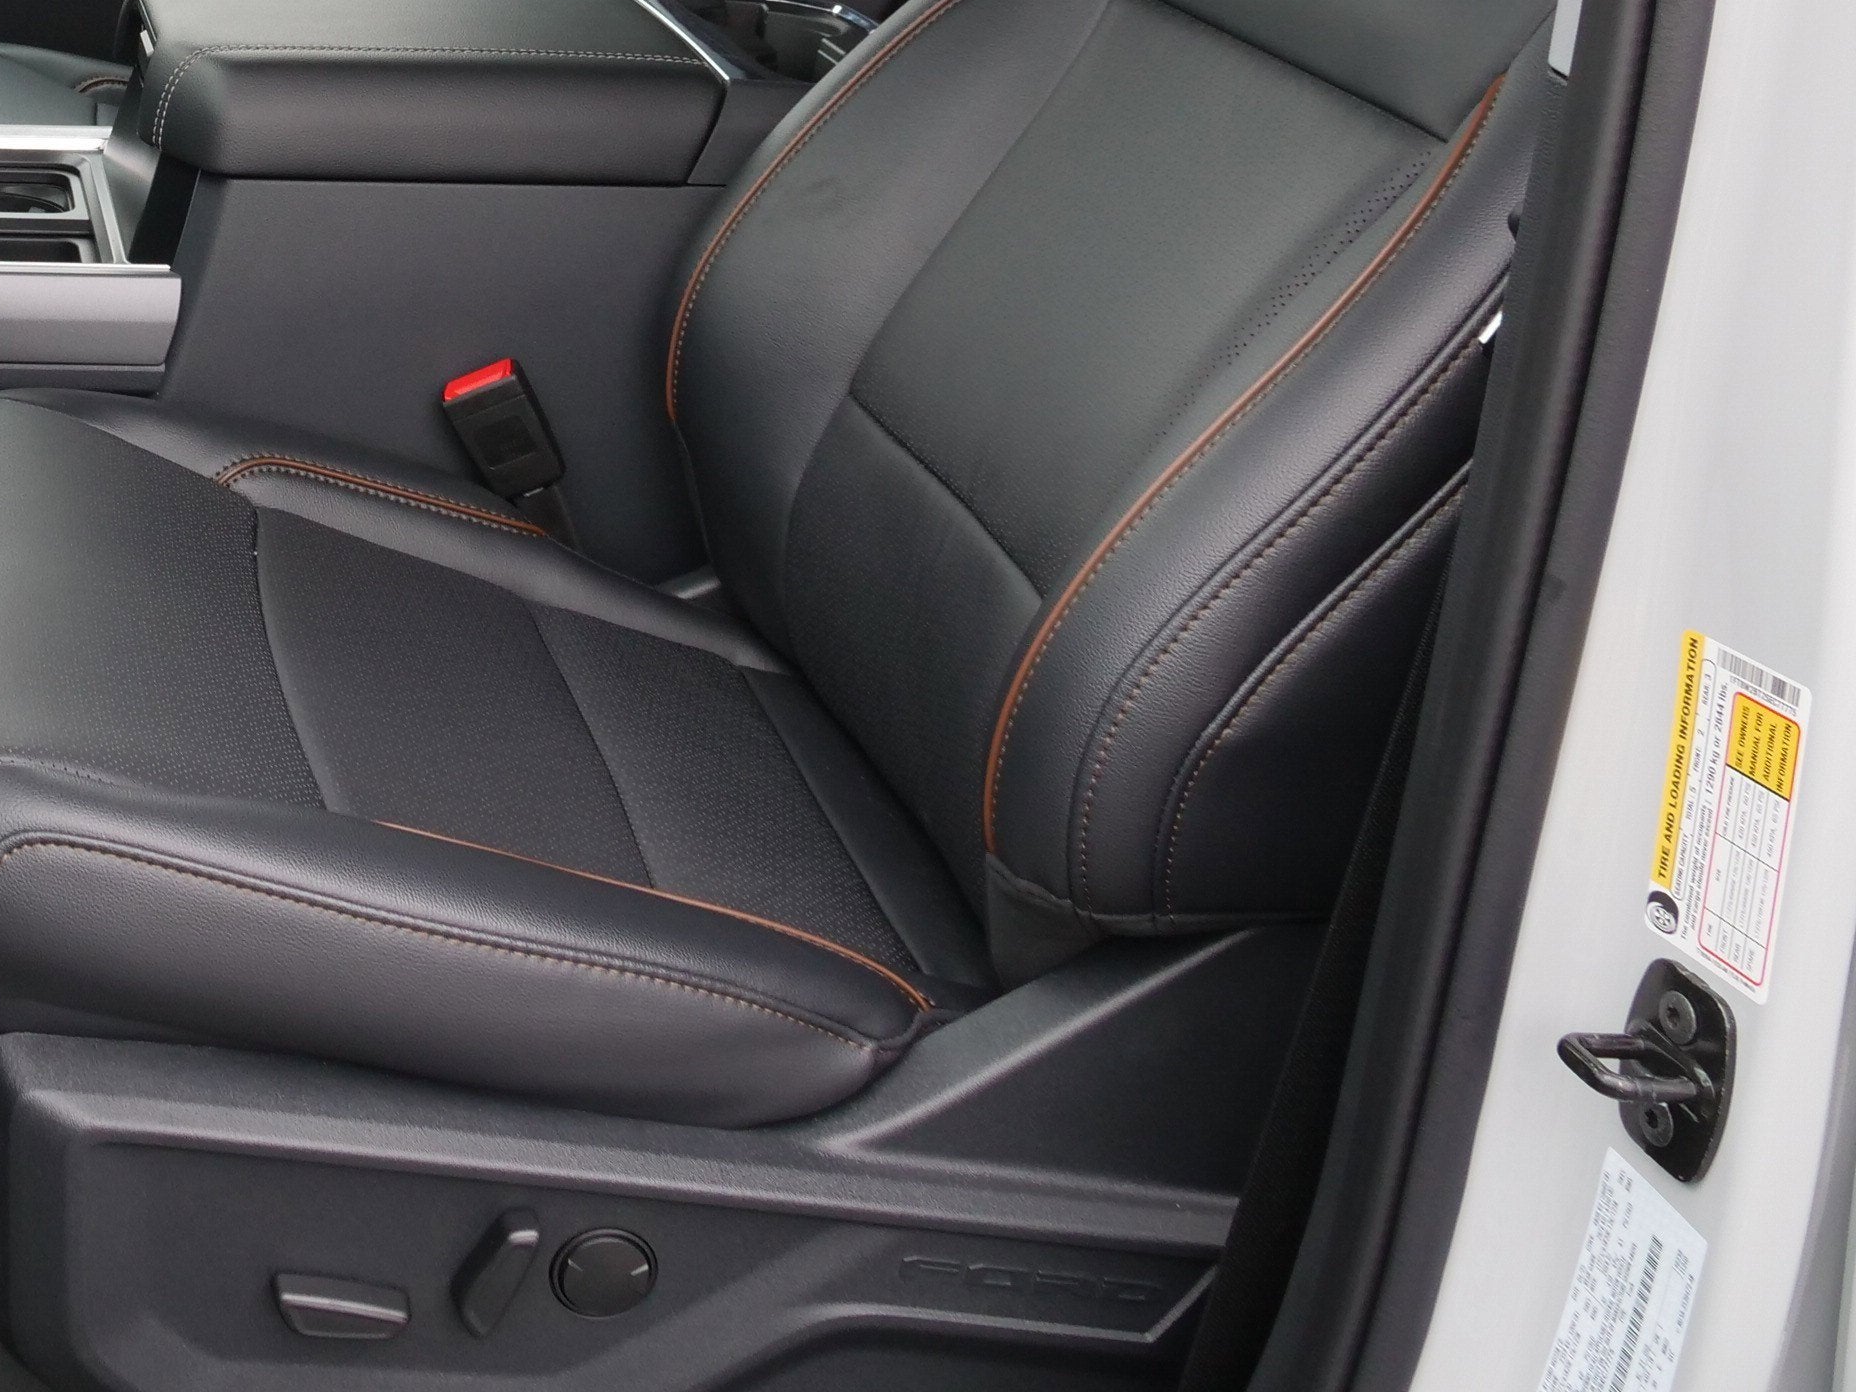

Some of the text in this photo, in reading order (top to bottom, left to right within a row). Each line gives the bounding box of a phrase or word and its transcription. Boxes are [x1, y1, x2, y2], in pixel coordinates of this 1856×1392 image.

[1714, 703, 1725, 732] 2844
[1714, 736, 1722, 748] or
[1735, 706, 1750, 768] SEE OWNERS
[1749, 712, 1764, 776] MANUAL FOR
[1658, 638, 1698, 878] TIRE AND LOADING INFORMATION
[1705, 766, 1717, 794] 1290
[1709, 750, 1721, 765] kg
[1763, 724, 1777, 781] ADDITIONAL
[1776, 723, 1792, 791] INFORMATION
[1674, 833, 1689, 895] SEATING CAPACITY
[1690, 856, 1699, 883] weight
